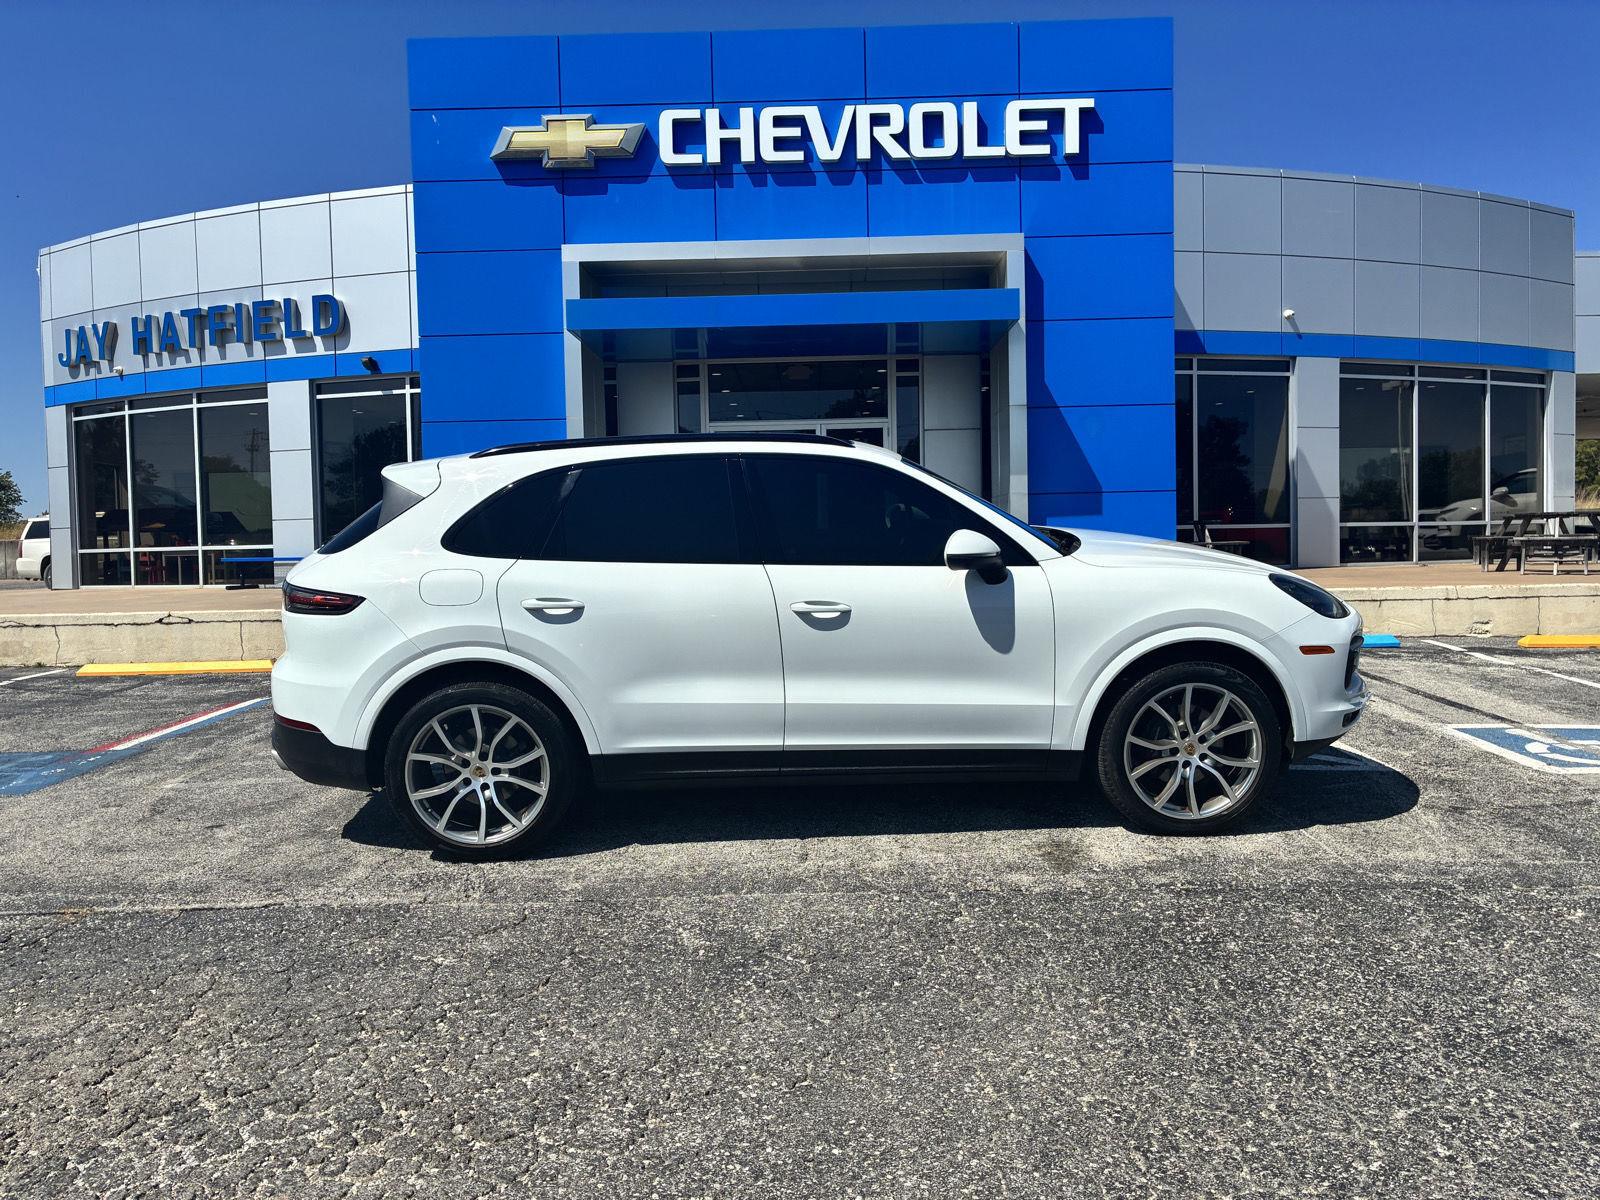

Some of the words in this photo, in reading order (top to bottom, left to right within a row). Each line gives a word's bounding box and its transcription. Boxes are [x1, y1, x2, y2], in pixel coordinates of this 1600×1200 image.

[658, 98, 1095, 166] CHEVROLET
[58, 321, 117, 368] JAY
[131, 294, 344, 356] HATFIELD
